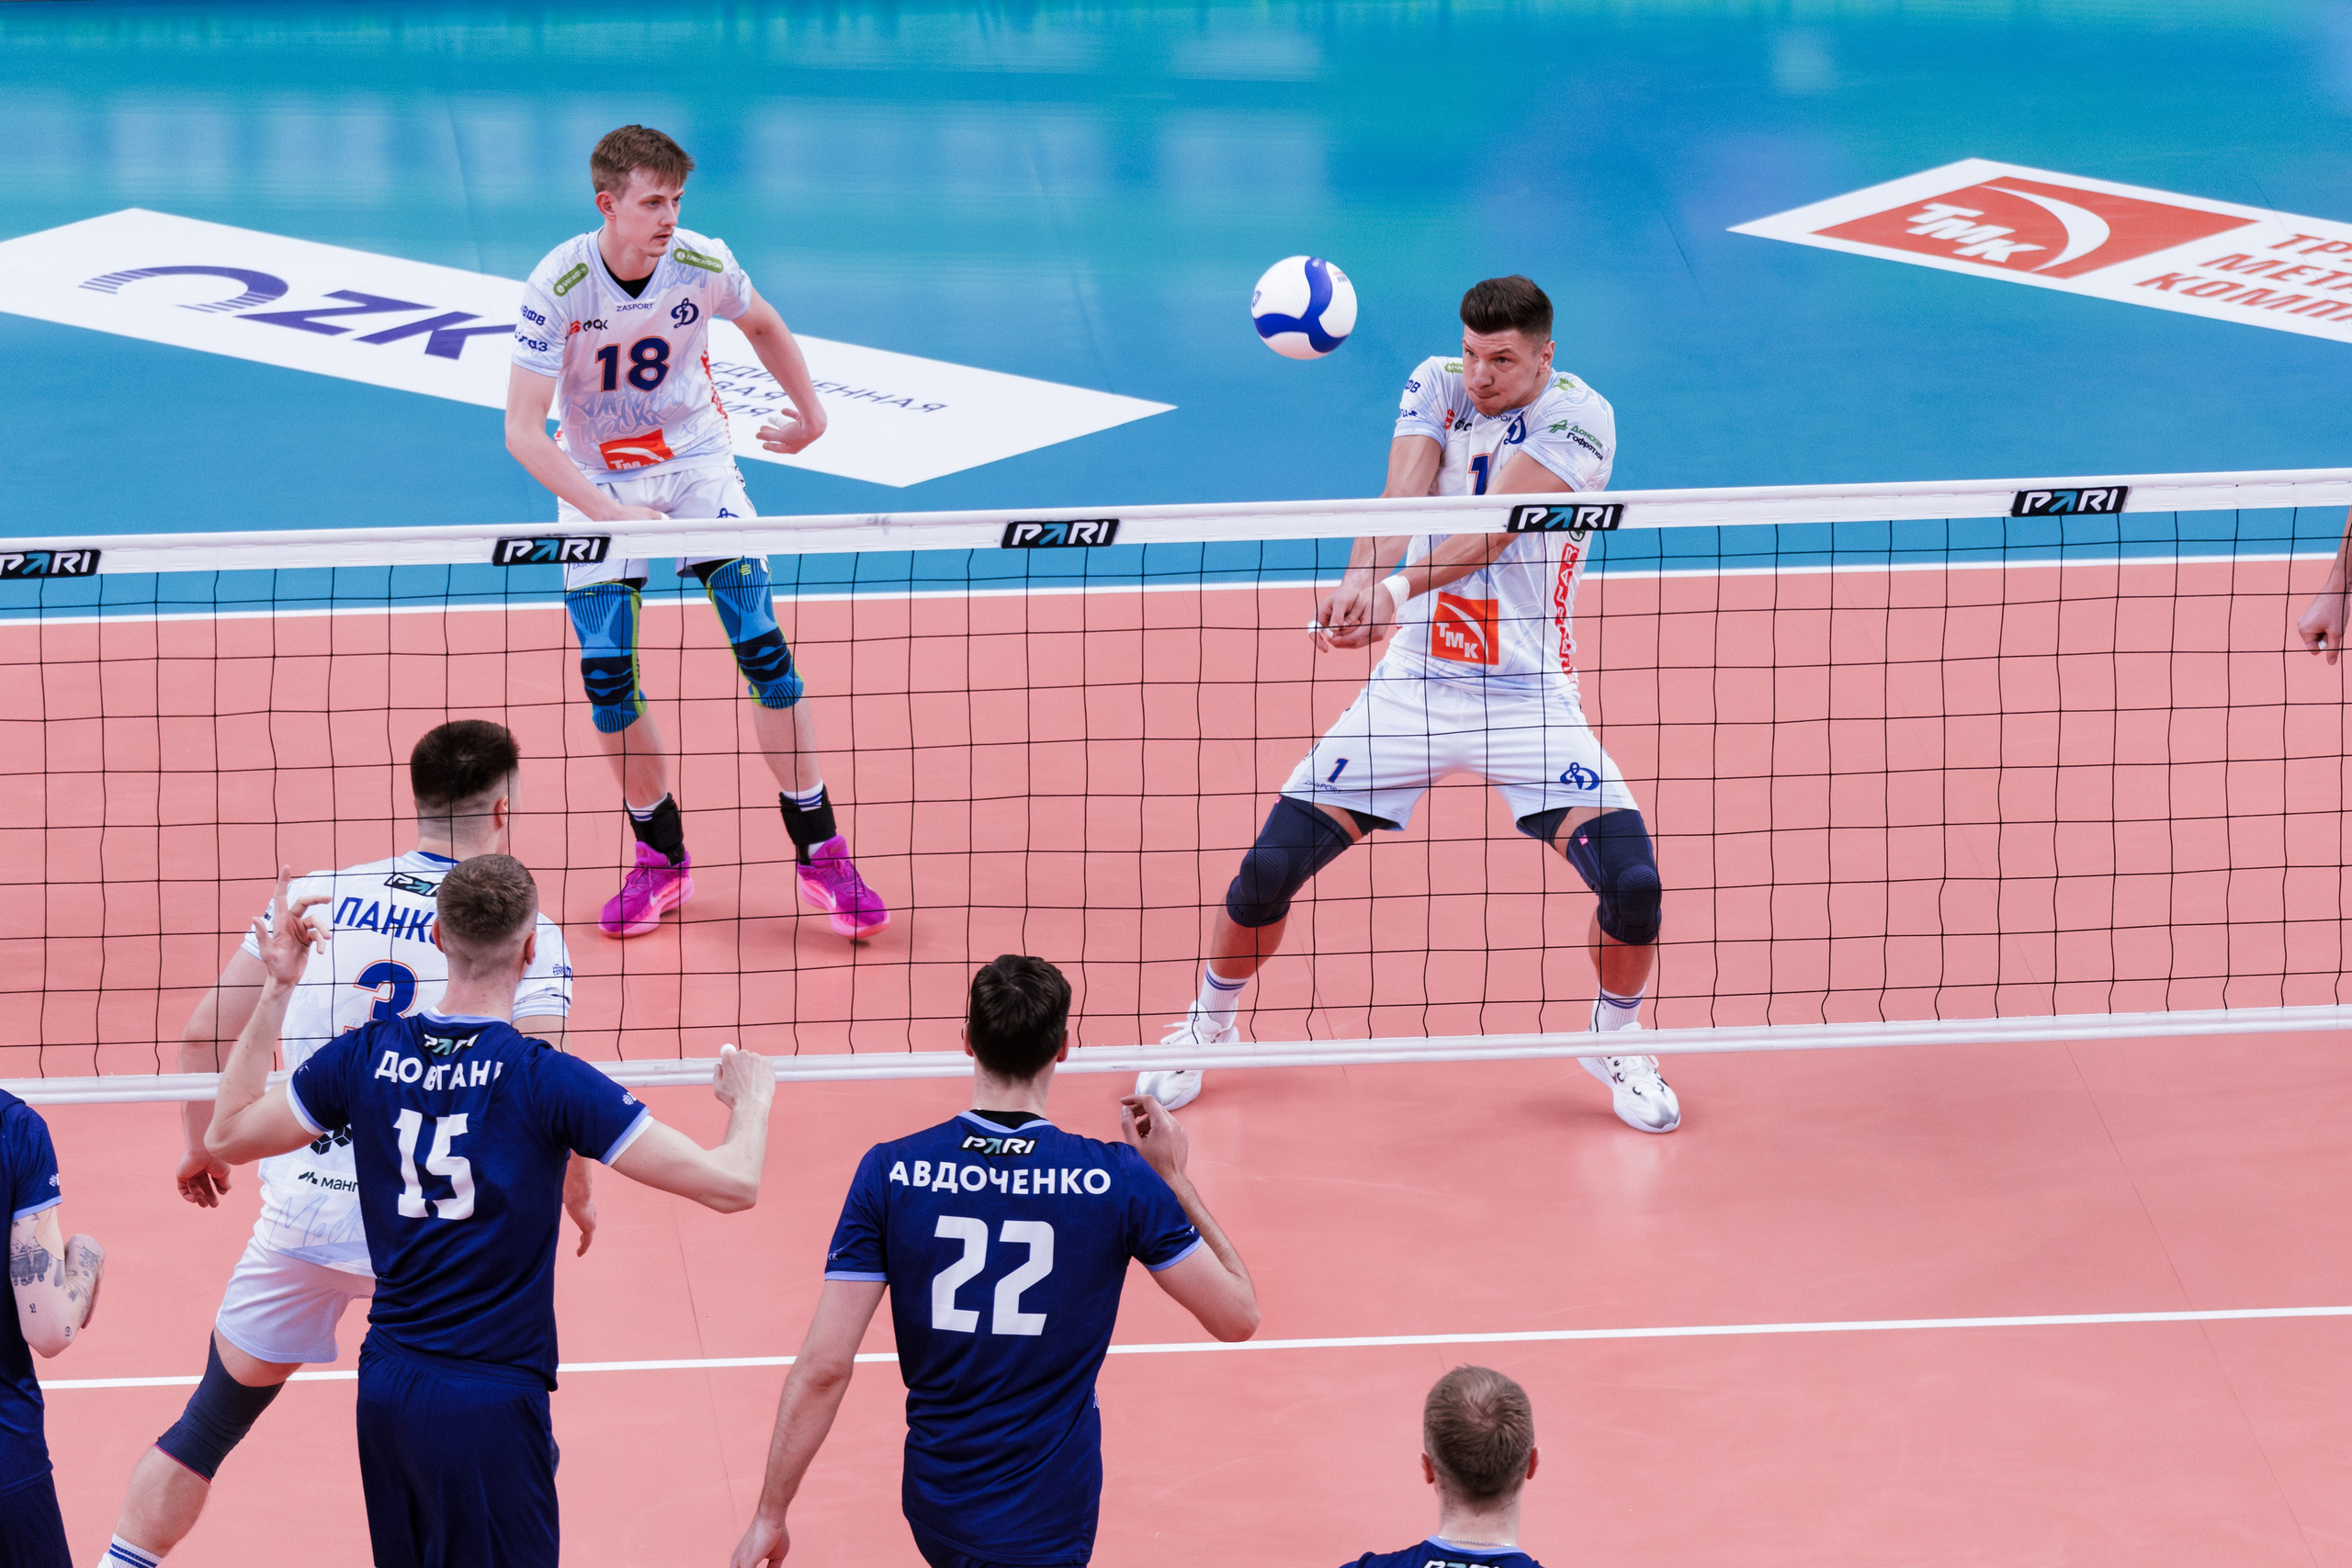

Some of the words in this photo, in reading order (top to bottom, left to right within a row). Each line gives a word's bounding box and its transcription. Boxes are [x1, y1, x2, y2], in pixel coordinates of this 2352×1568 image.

[2266, 233, 2352, 263] ТР
[616, 303, 654, 311] ZASPORT
[594, 335, 672, 393] 18
[1468, 453, 1491, 496] 1
[2021, 489, 2119, 513] PARI
[1517, 506, 1614, 530] PARI
[1012, 521, 1109, 546] PARI
[0, 551, 91, 576] PARI
[503, 538, 600, 562] PARI
[1327, 757, 1350, 784] 1
[334, 897, 436, 945] ПАНК
[962, 1135, 1035, 1155] PARI
[393, 1108, 475, 1220] 15
[889, 1160, 1112, 1195] АВДОЧЕНКО
[932, 1215, 1055, 1336] 22
